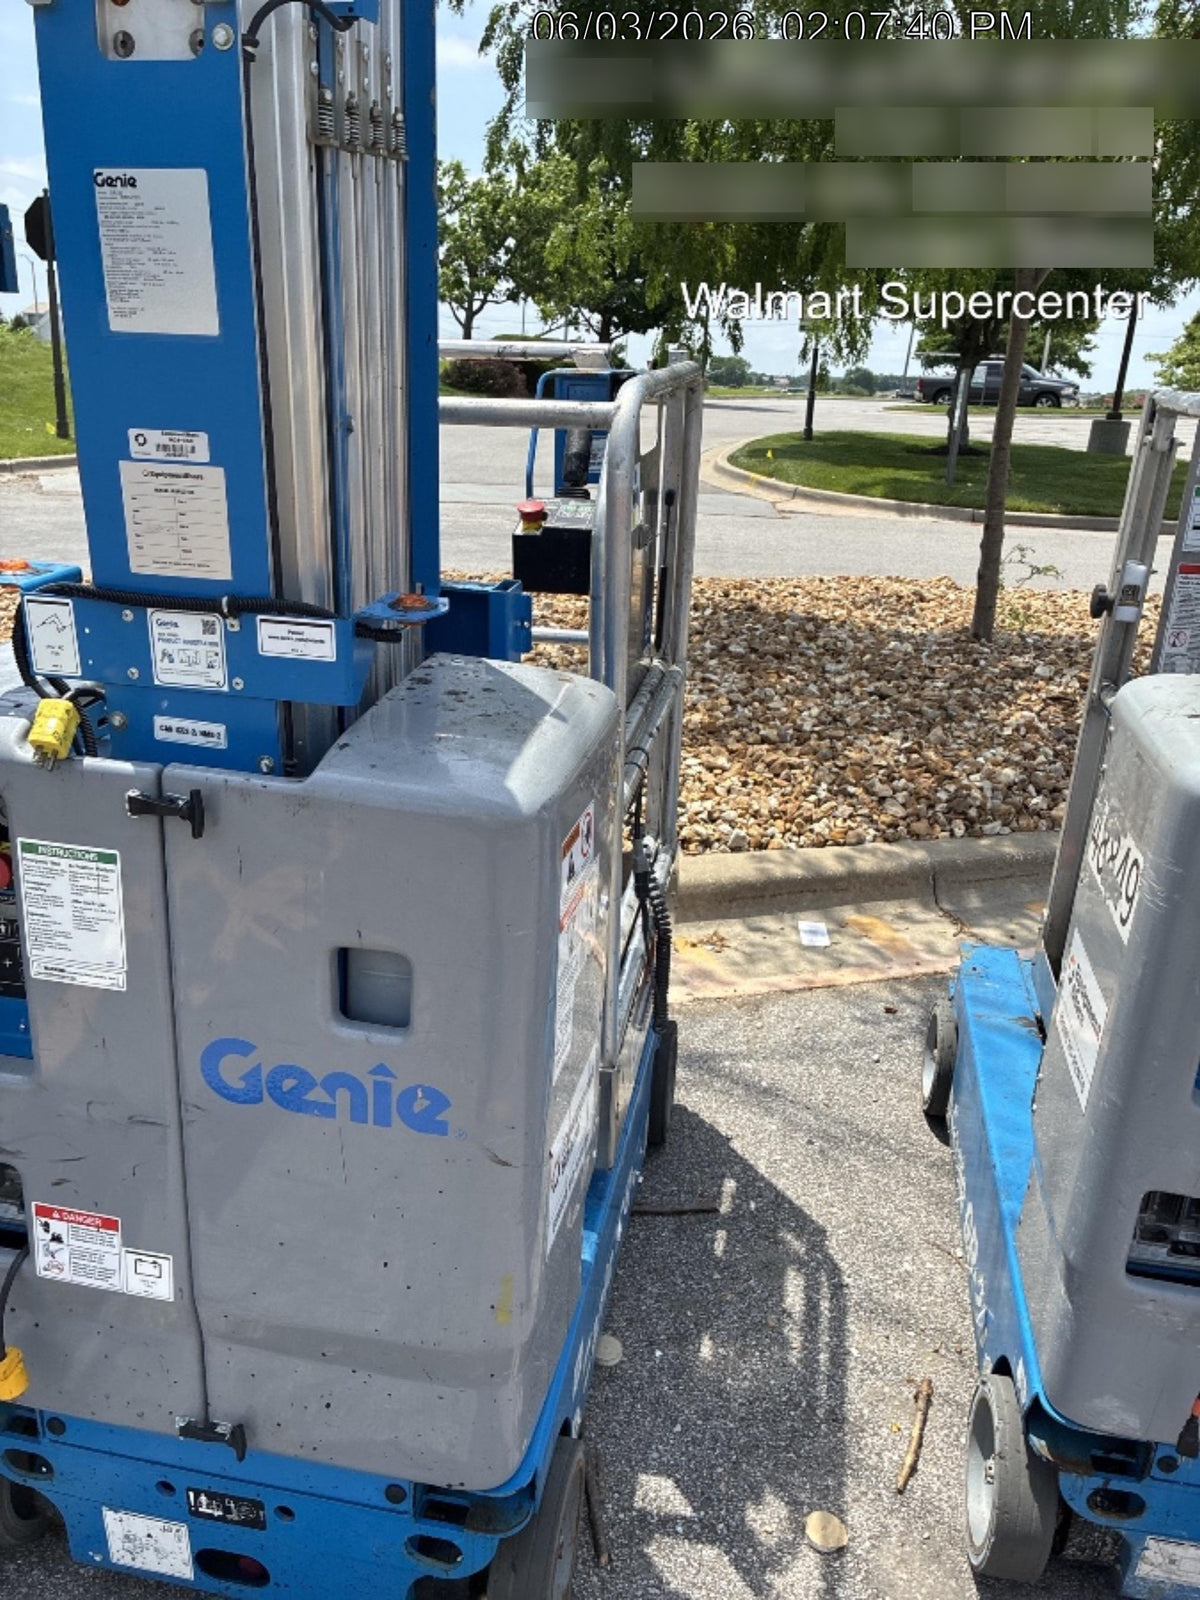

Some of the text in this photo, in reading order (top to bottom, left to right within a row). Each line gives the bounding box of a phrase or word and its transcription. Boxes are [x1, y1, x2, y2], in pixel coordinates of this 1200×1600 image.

[94, 171, 138, 189] Genie
[38, 845, 99, 862] INSTRUCTIONS
[62, 1211, 102, 1227] DANGER
